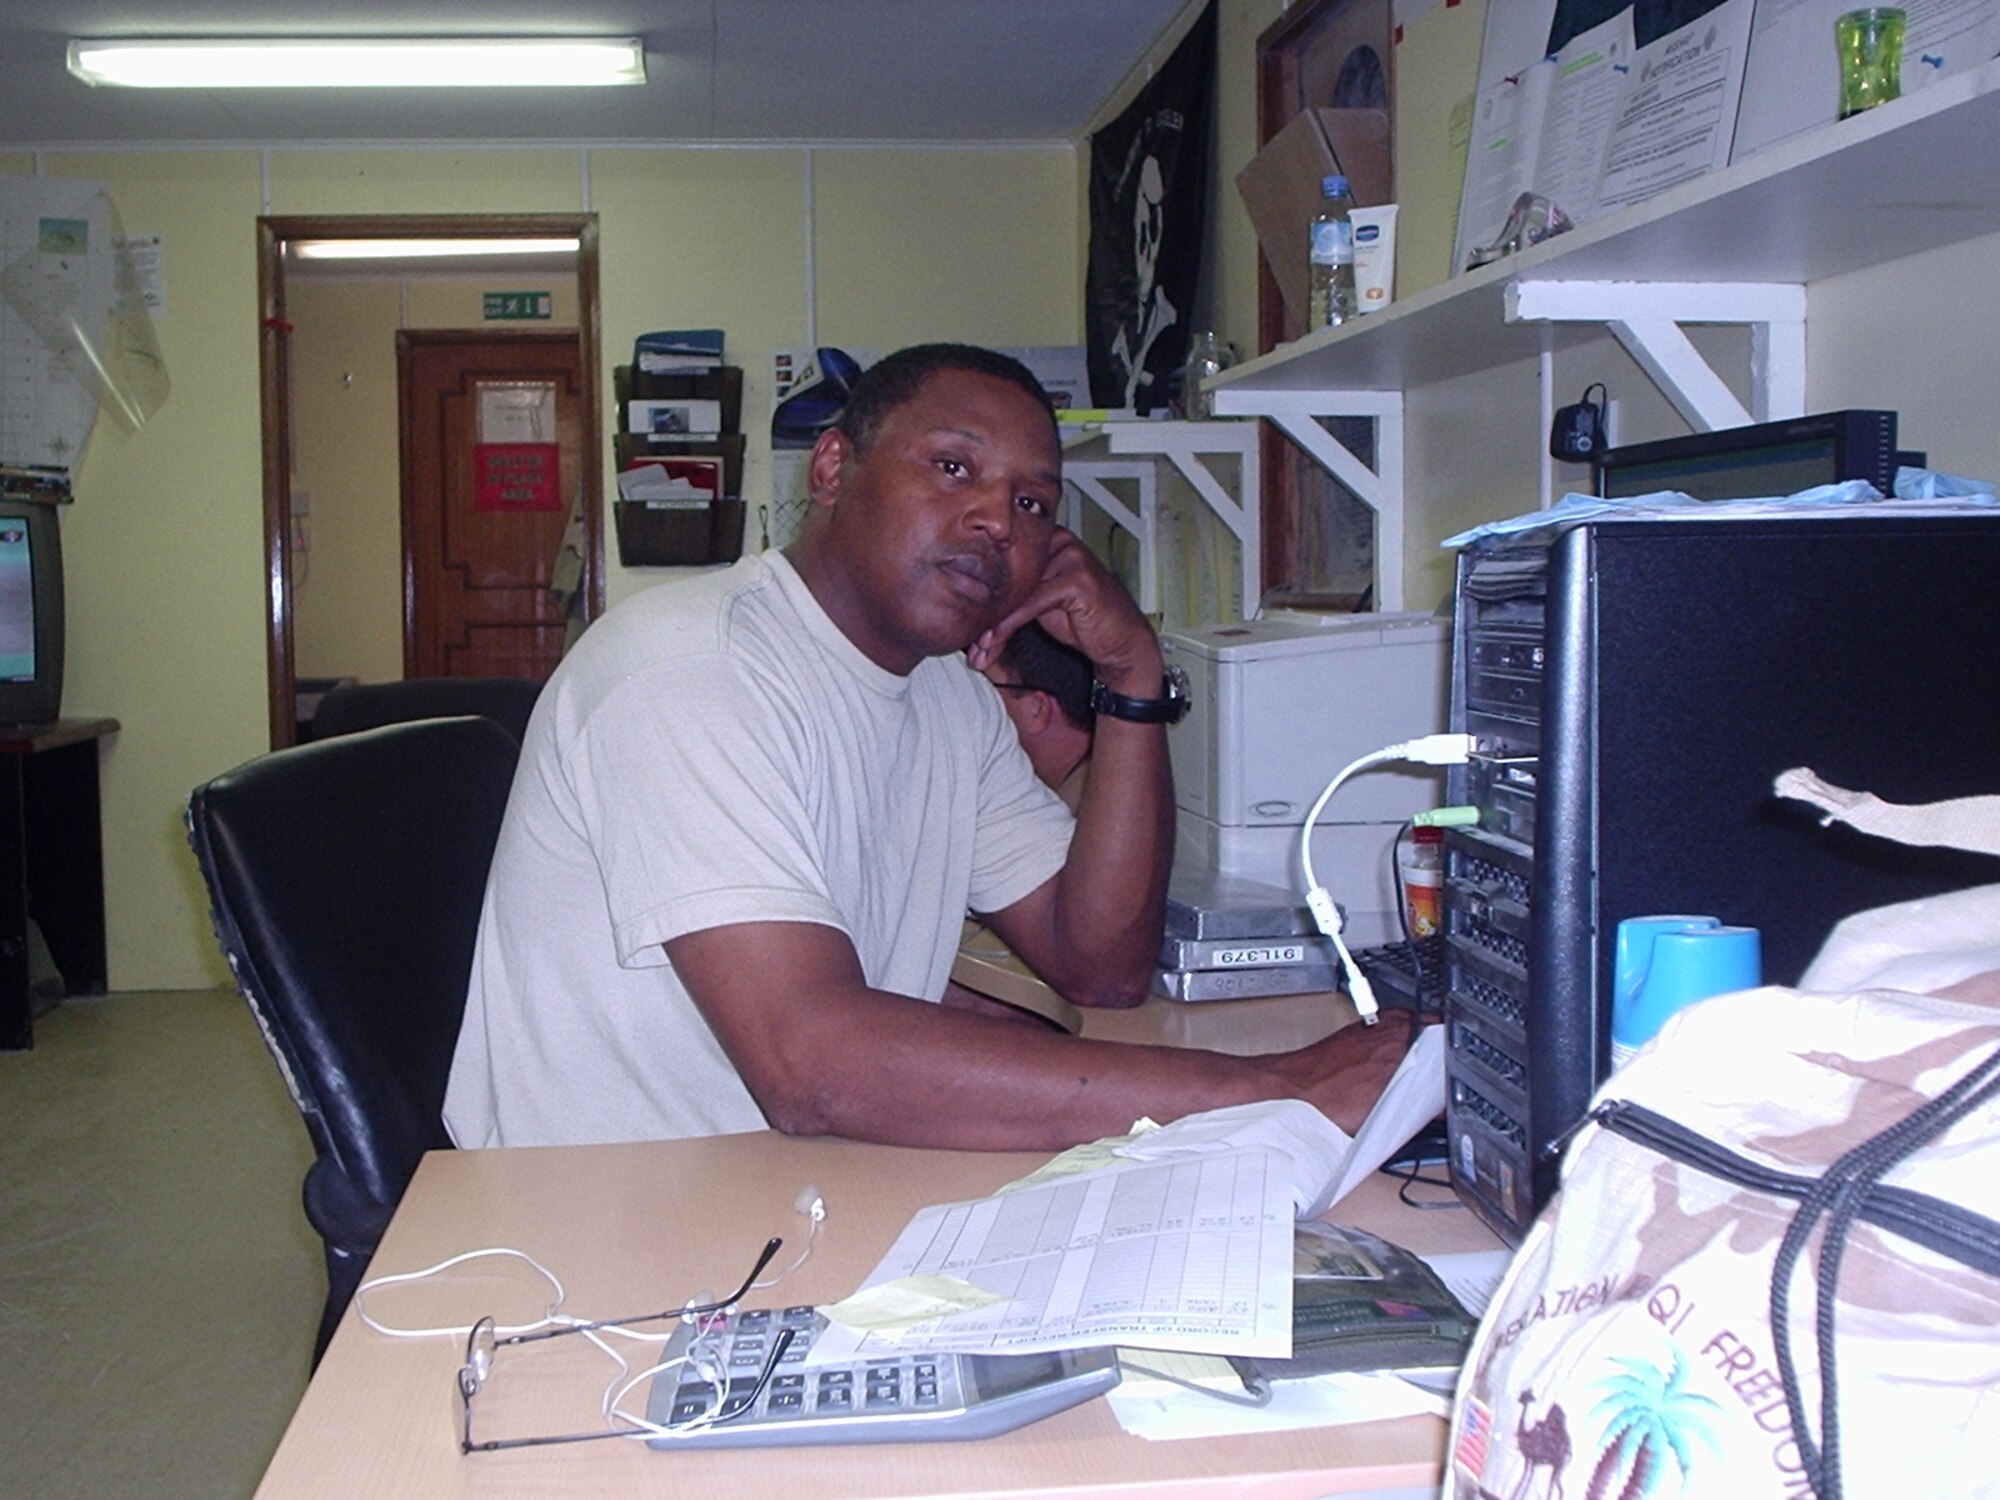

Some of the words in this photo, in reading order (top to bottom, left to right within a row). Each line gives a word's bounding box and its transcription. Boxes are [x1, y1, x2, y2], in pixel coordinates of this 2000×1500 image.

[1221, 949, 1295, 963] 91L379
[1153, 1325, 1173, 1333] OF
[1176, 1326, 1240, 1336] RECORD
